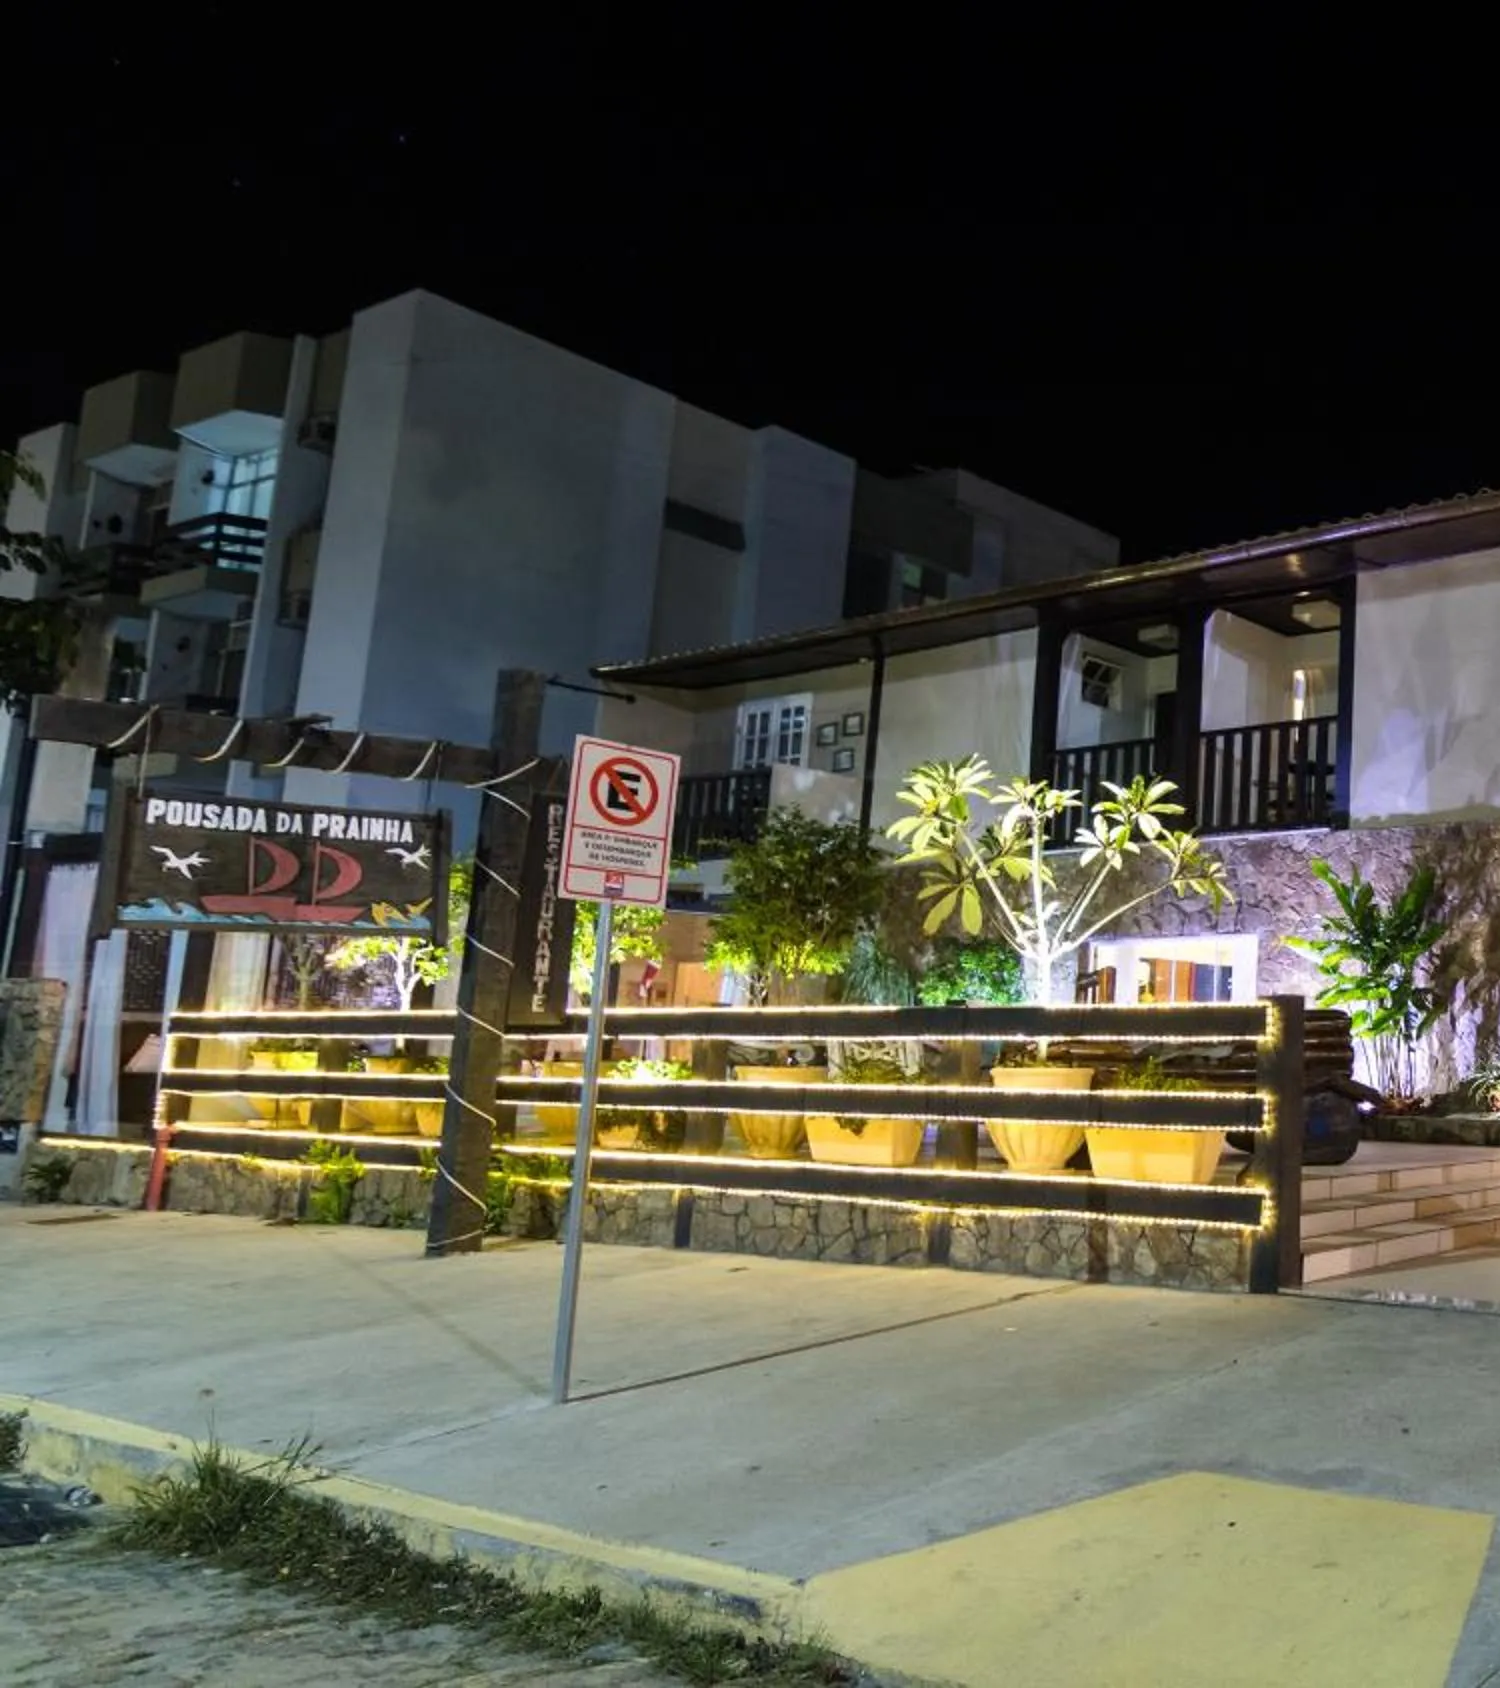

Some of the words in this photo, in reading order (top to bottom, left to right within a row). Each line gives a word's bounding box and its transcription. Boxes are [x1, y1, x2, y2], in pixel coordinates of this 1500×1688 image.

[607, 769, 642, 812] E
[146, 798, 267, 833] POUSADA
[276, 811, 303, 834] DA
[311, 812, 414, 843] PRAINHA
[531, 803, 564, 1013] RESTAURANTE
